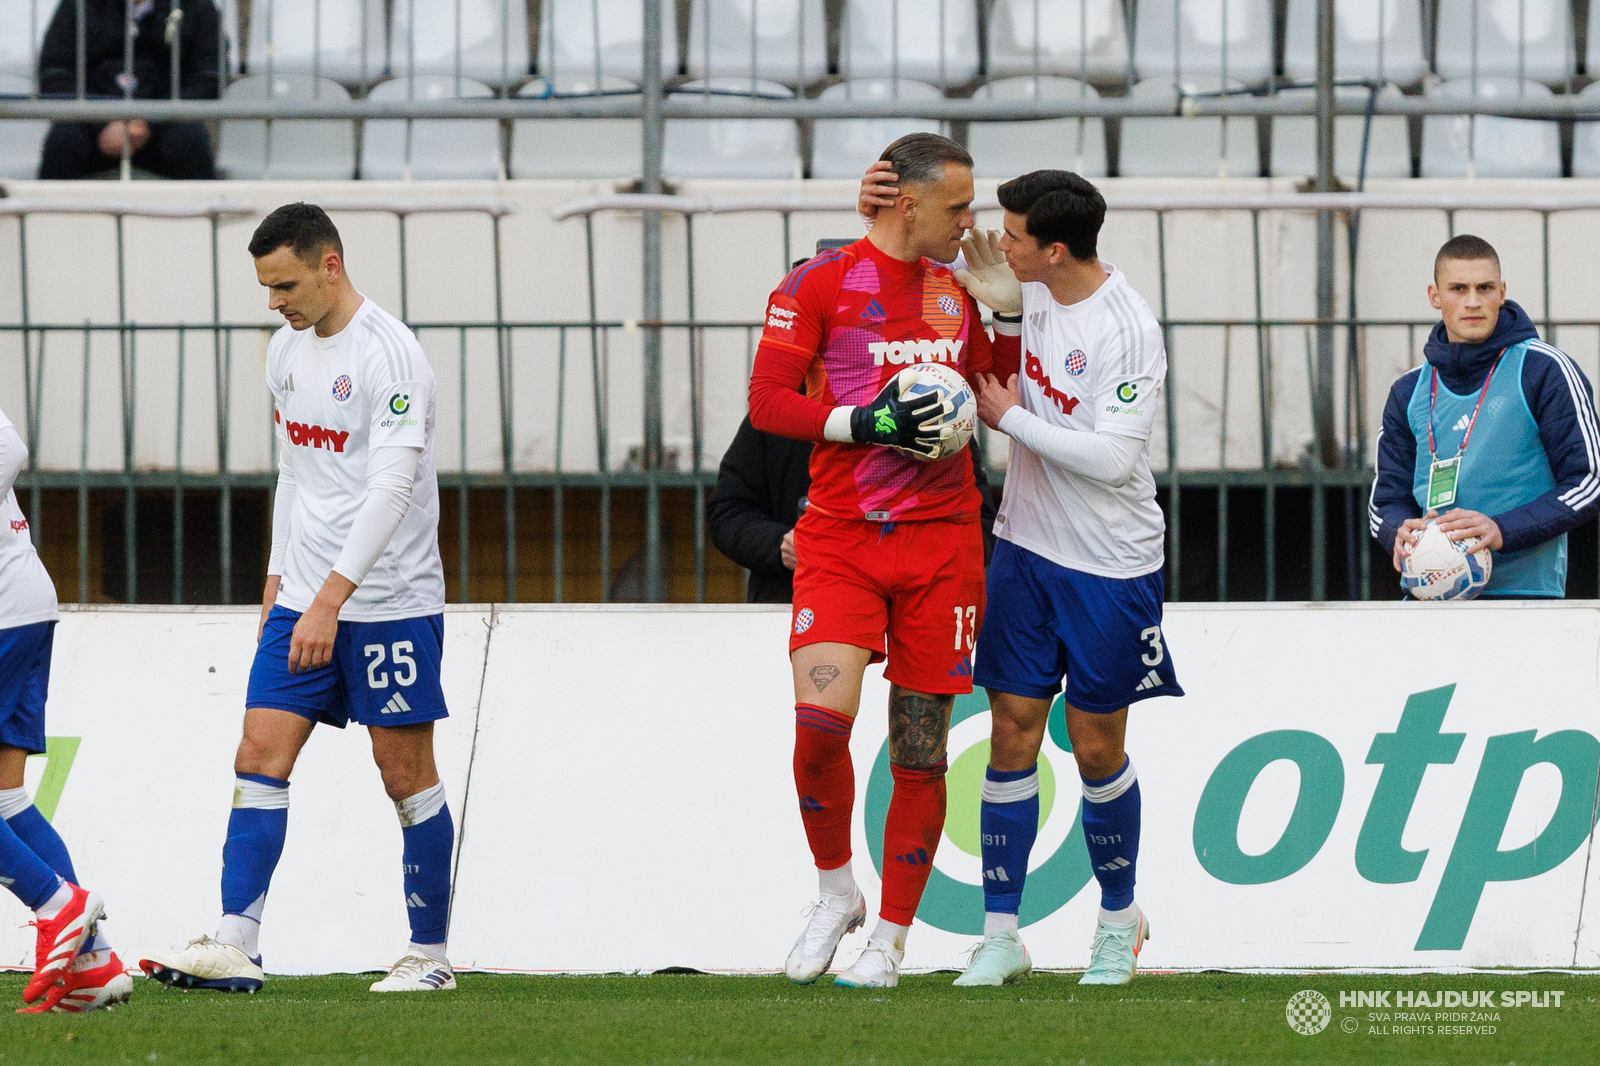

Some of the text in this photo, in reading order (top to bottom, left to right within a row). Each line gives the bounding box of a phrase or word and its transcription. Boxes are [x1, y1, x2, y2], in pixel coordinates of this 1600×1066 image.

[767, 315, 793, 330] Sport
[769, 303, 797, 319] Super
[868, 339, 964, 366] TOMMY
[953, 605, 976, 650] 13
[1140, 625, 1164, 668] 3
[364, 640, 417, 689] 25
[1193, 683, 1600, 951] otp
[982, 833, 1007, 846] 1911
[1089, 834, 1122, 845] 1911
